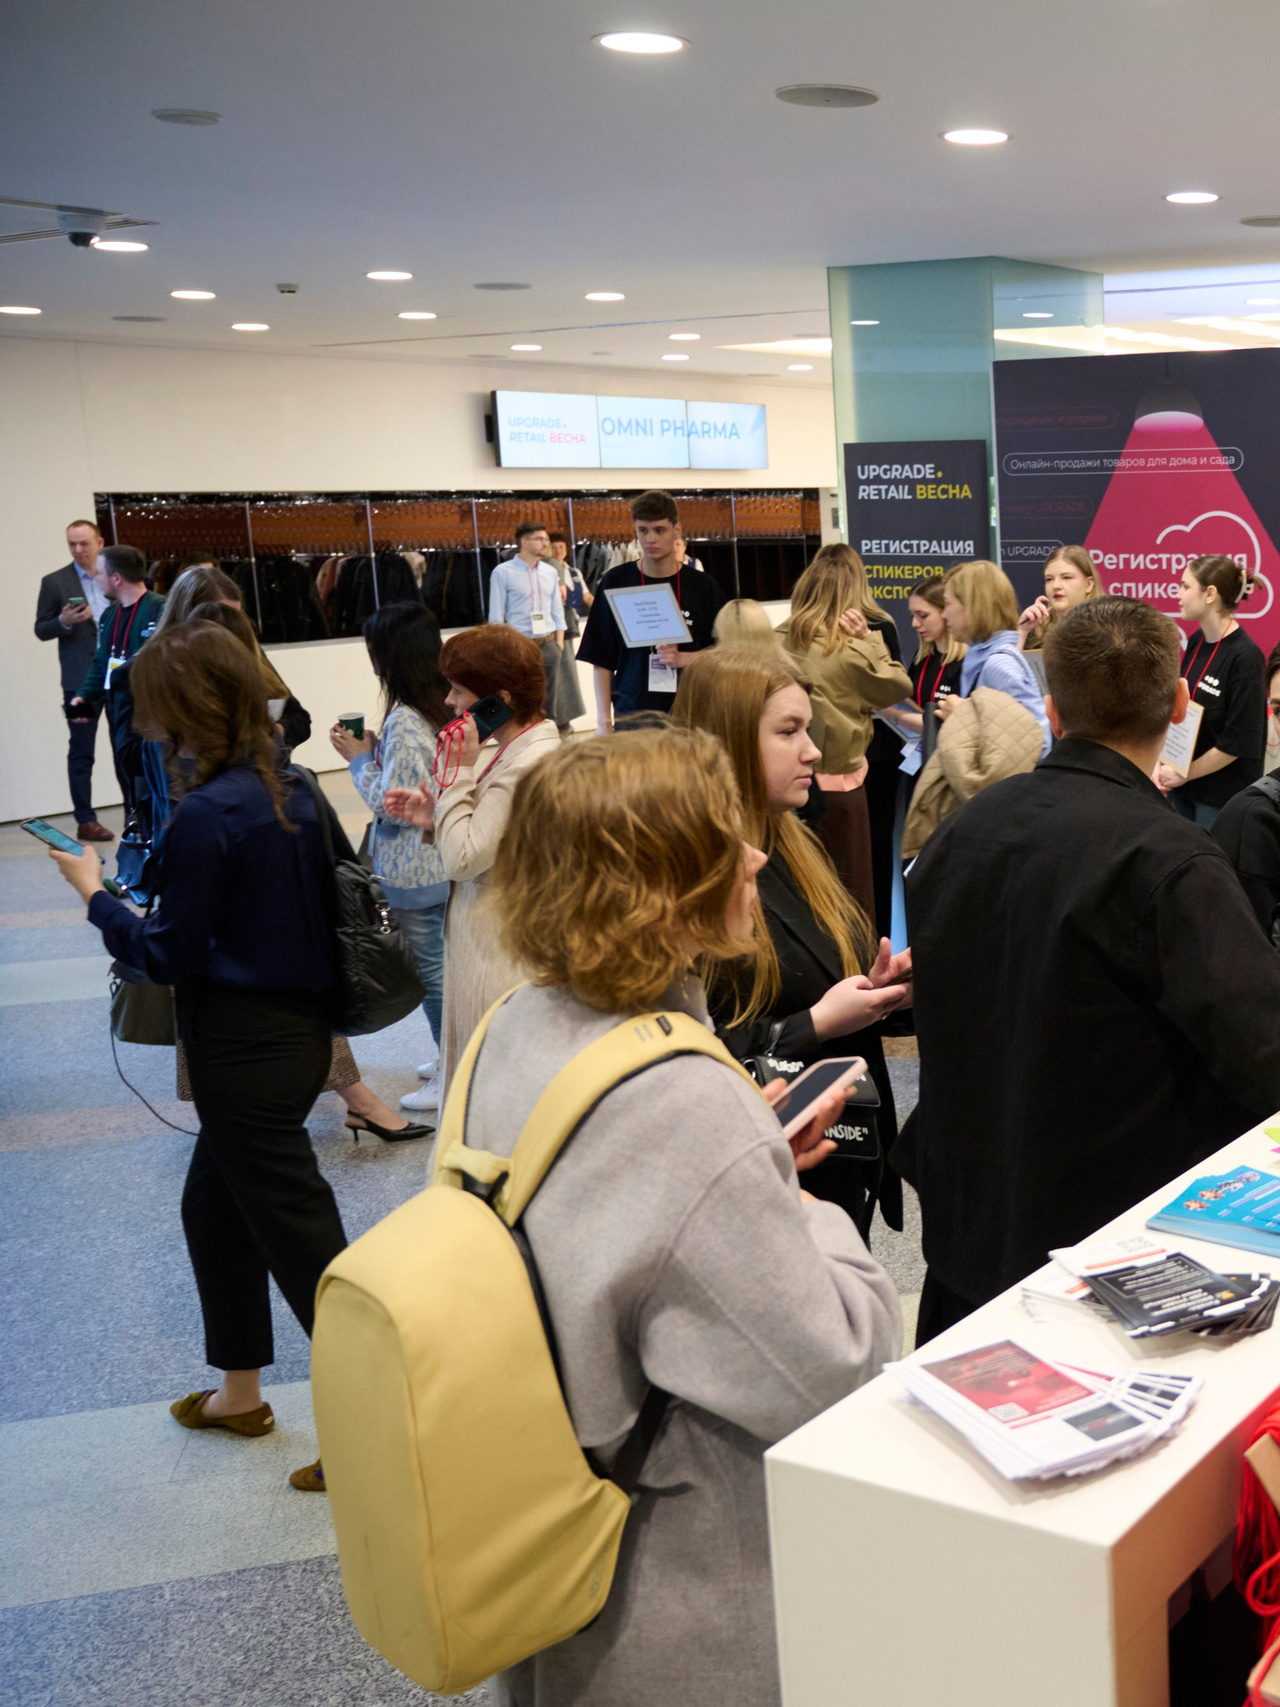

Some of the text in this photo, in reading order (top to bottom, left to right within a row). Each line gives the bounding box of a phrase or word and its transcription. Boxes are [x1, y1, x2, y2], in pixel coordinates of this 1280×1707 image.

[600, 417, 741, 440] OMNI PHARMA
[509, 432, 587, 444] RETAIL ВЕСНА
[1010, 454, 1236, 470] Онлайн-продажи товаров для дома и сада
[857, 484, 973, 500] RETAIL ВЕСНА
[860, 540, 975, 556] РЕГИСТРАЦИЯ
